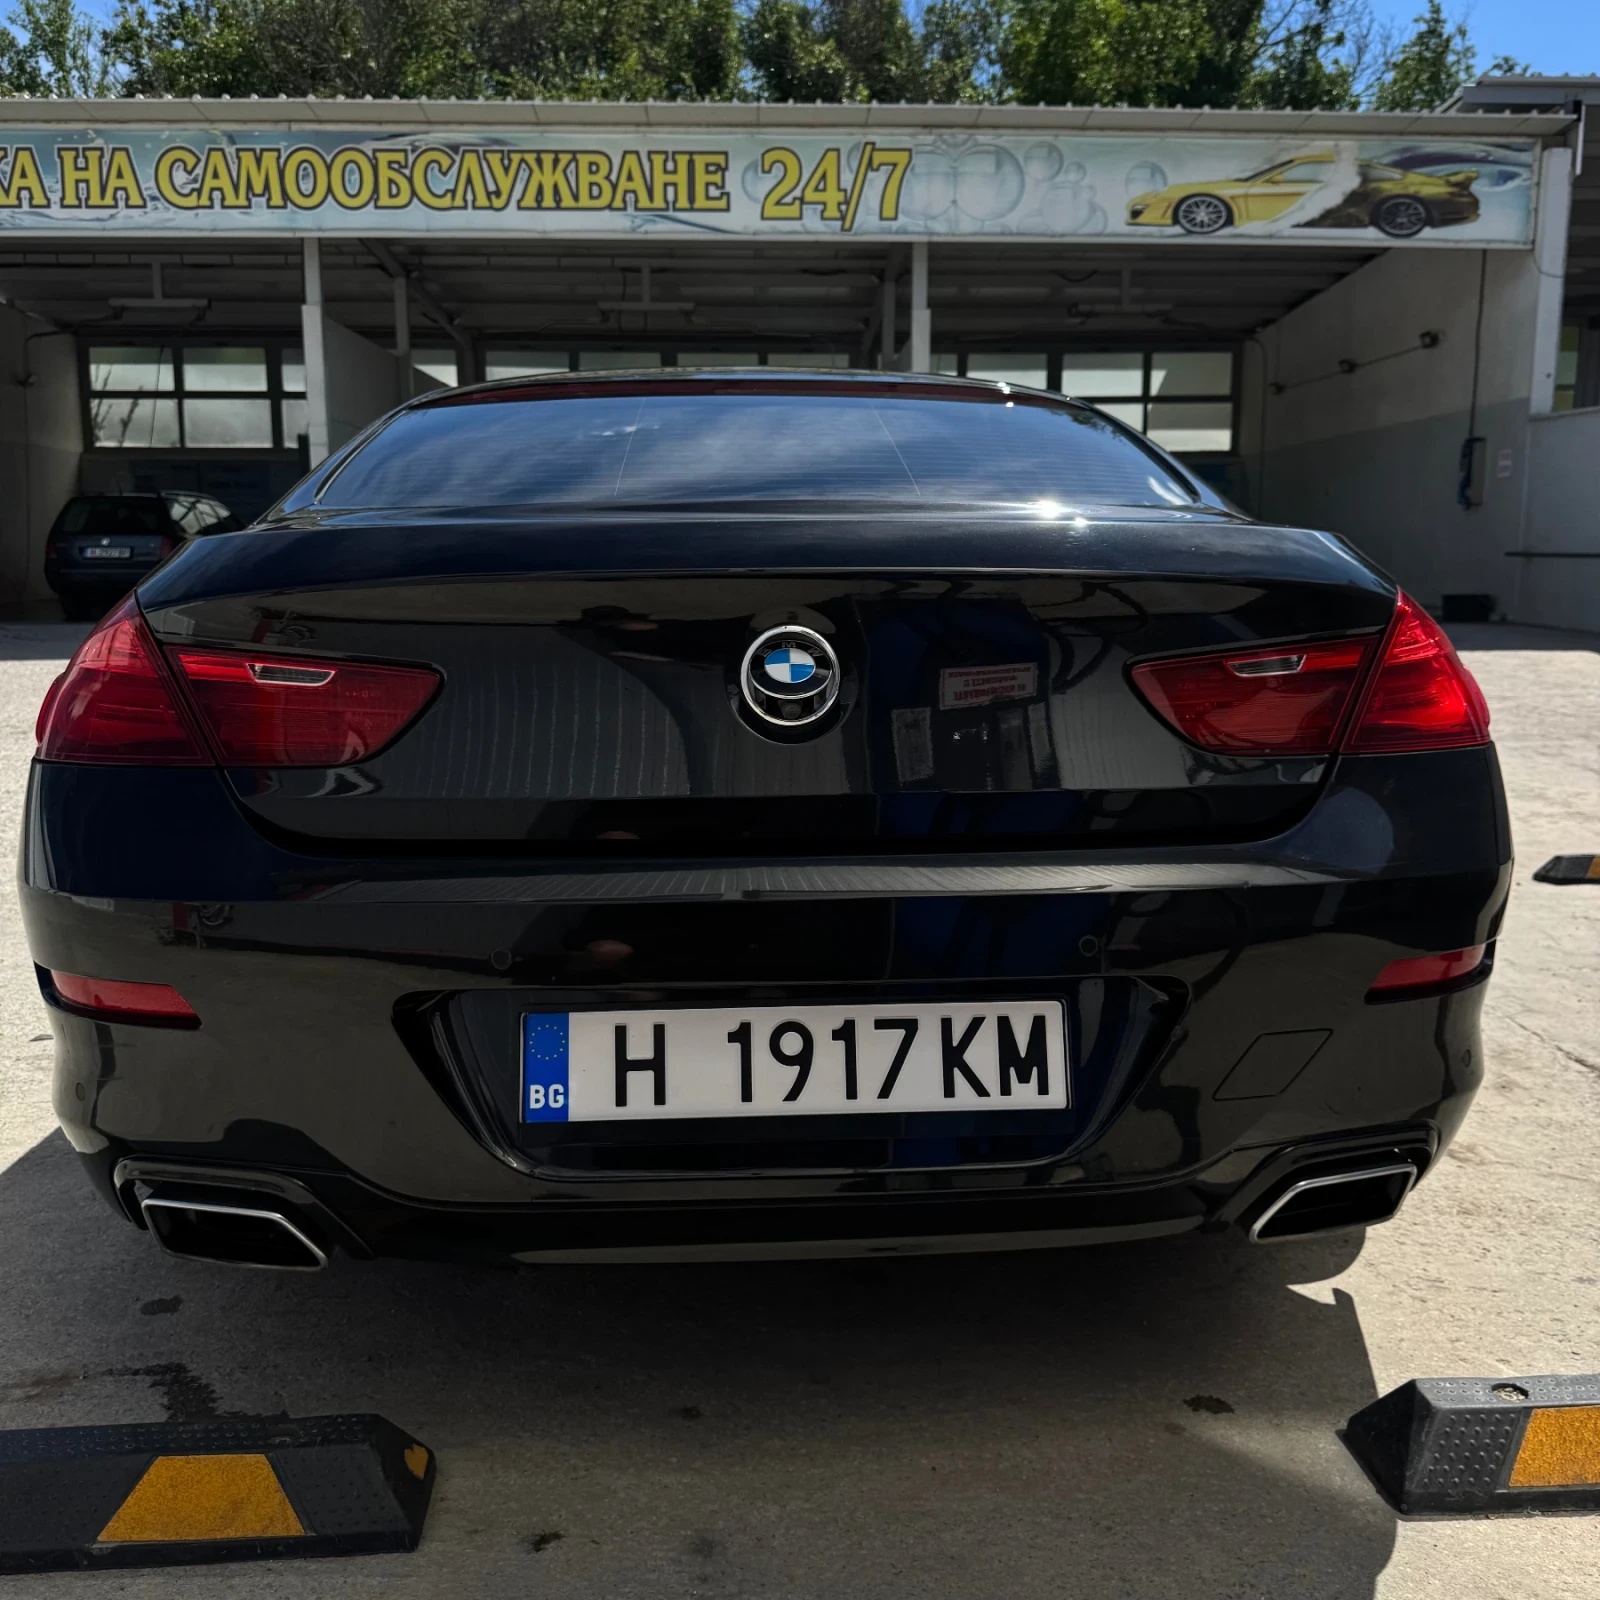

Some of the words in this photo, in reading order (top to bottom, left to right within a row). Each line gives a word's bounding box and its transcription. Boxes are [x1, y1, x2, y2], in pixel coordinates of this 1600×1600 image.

[57, 147, 146, 209] НА
[155, 147, 730, 211] САМООБСЛУЖВАНЕ
[761, 142, 912, 231] 24/7
[759, 641, 823, 657] BMW
[614, 1022, 667, 1107] H
[727, 1016, 919, 1103] 1917
[941, 1014, 1050, 1098] KM
[528, 1084, 565, 1109] BG
